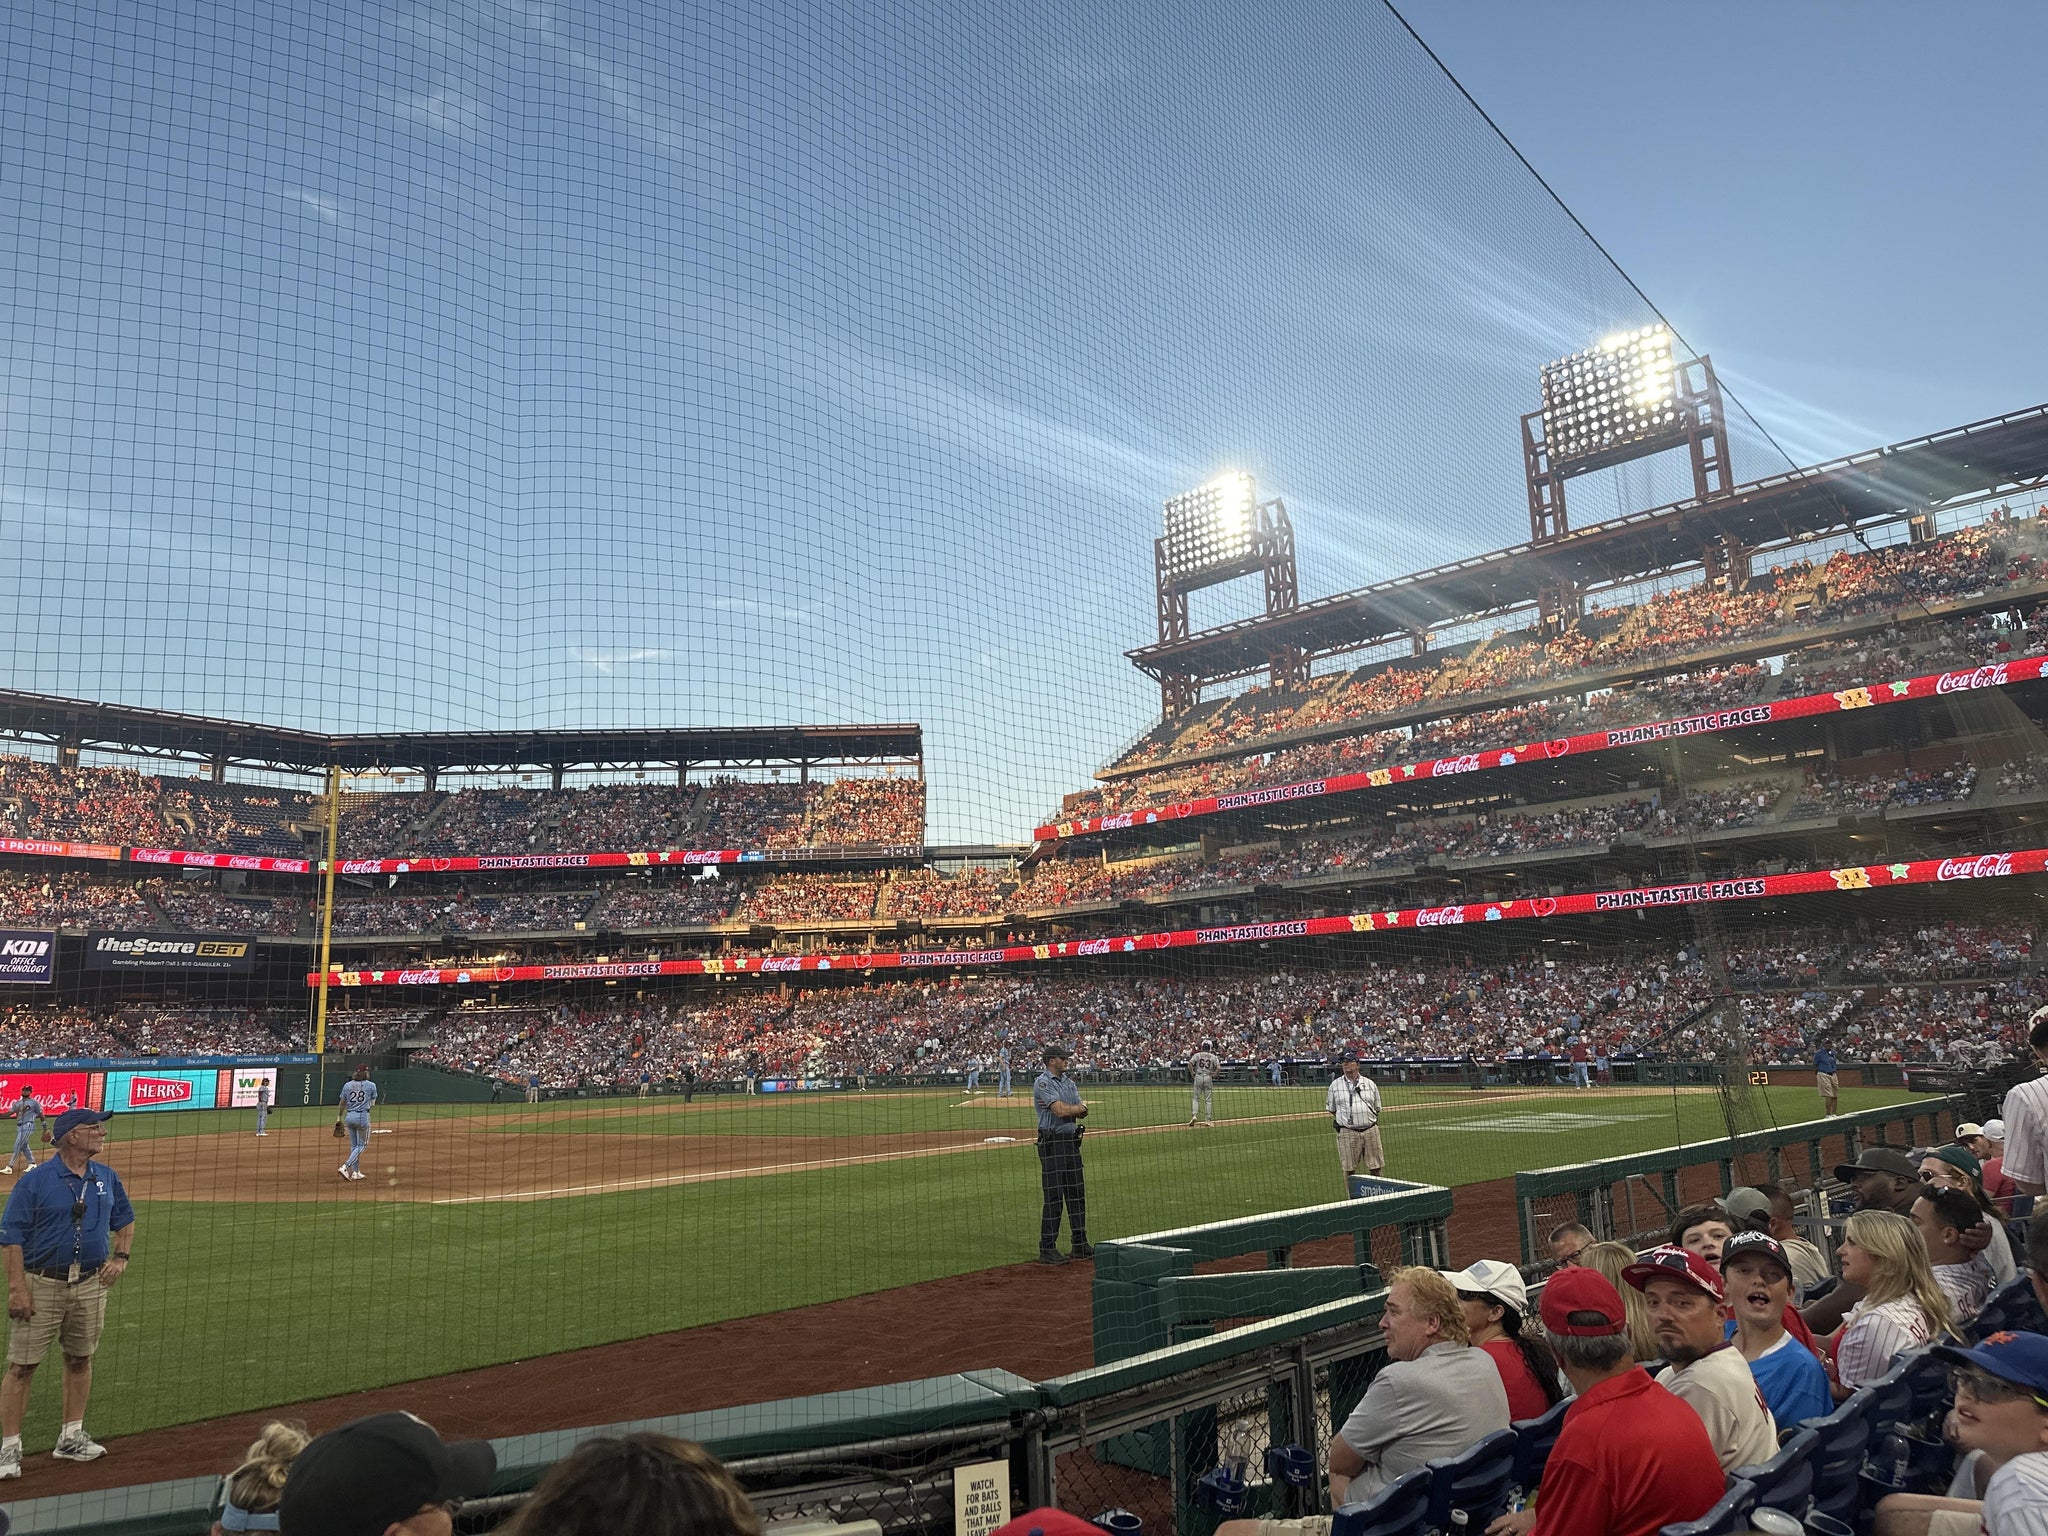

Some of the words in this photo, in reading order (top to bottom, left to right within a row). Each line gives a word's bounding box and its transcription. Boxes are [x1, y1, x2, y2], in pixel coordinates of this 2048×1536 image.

[1608, 715, 1717, 746] PHAN-TASTIC
[1718, 706, 1772, 729] FACES
[1217, 788, 1290, 809] PHAN-TASTIC
[1290, 781, 1326, 797] FACES
[10, 841, 62, 852] PROTEIN
[478, 856, 554, 868] PHAN-TASTIC
[555, 855, 589, 866] FACES
[1936, 852, 2013, 881] Coca-Cola
[1596, 885, 1709, 909] PHAN-TASTIC
[1711, 880, 1766, 898] FACES
[1416, 905, 1466, 927] Coca-Cola
[1197, 926, 1270, 942] PHAN-TASTIC
[1271, 922, 1307, 937] FACES
[0, 940, 49, 956] KDI
[96, 937, 196, 955] theScore
[200, 942, 244, 955] BET
[10, 957, 37, 965] OFFICE
[901, 954, 976, 964] PHAN-TASTIC
[978, 951, 1004, 962] FACES
[0, 965, 48, 973] TECHNOLOGY
[544, 965, 624, 978] PHAN-TASTIC
[625, 963, 662, 976] FACES
[1199, 1058, 1211, 1069] 63
[136, 1083, 185, 1098] HERR'S
[349, 1090, 365, 1103] 28
[970, 1478, 994, 1492] WATCH
[966, 1493, 980, 1505] FOR
[981, 1489, 999, 1501] BATS
[964, 1505, 979, 1517] AND
[980, 1501, 1002, 1514] BALLS
[966, 1516, 983, 1529] THAT
[985, 1513, 1001, 1525] MAY
